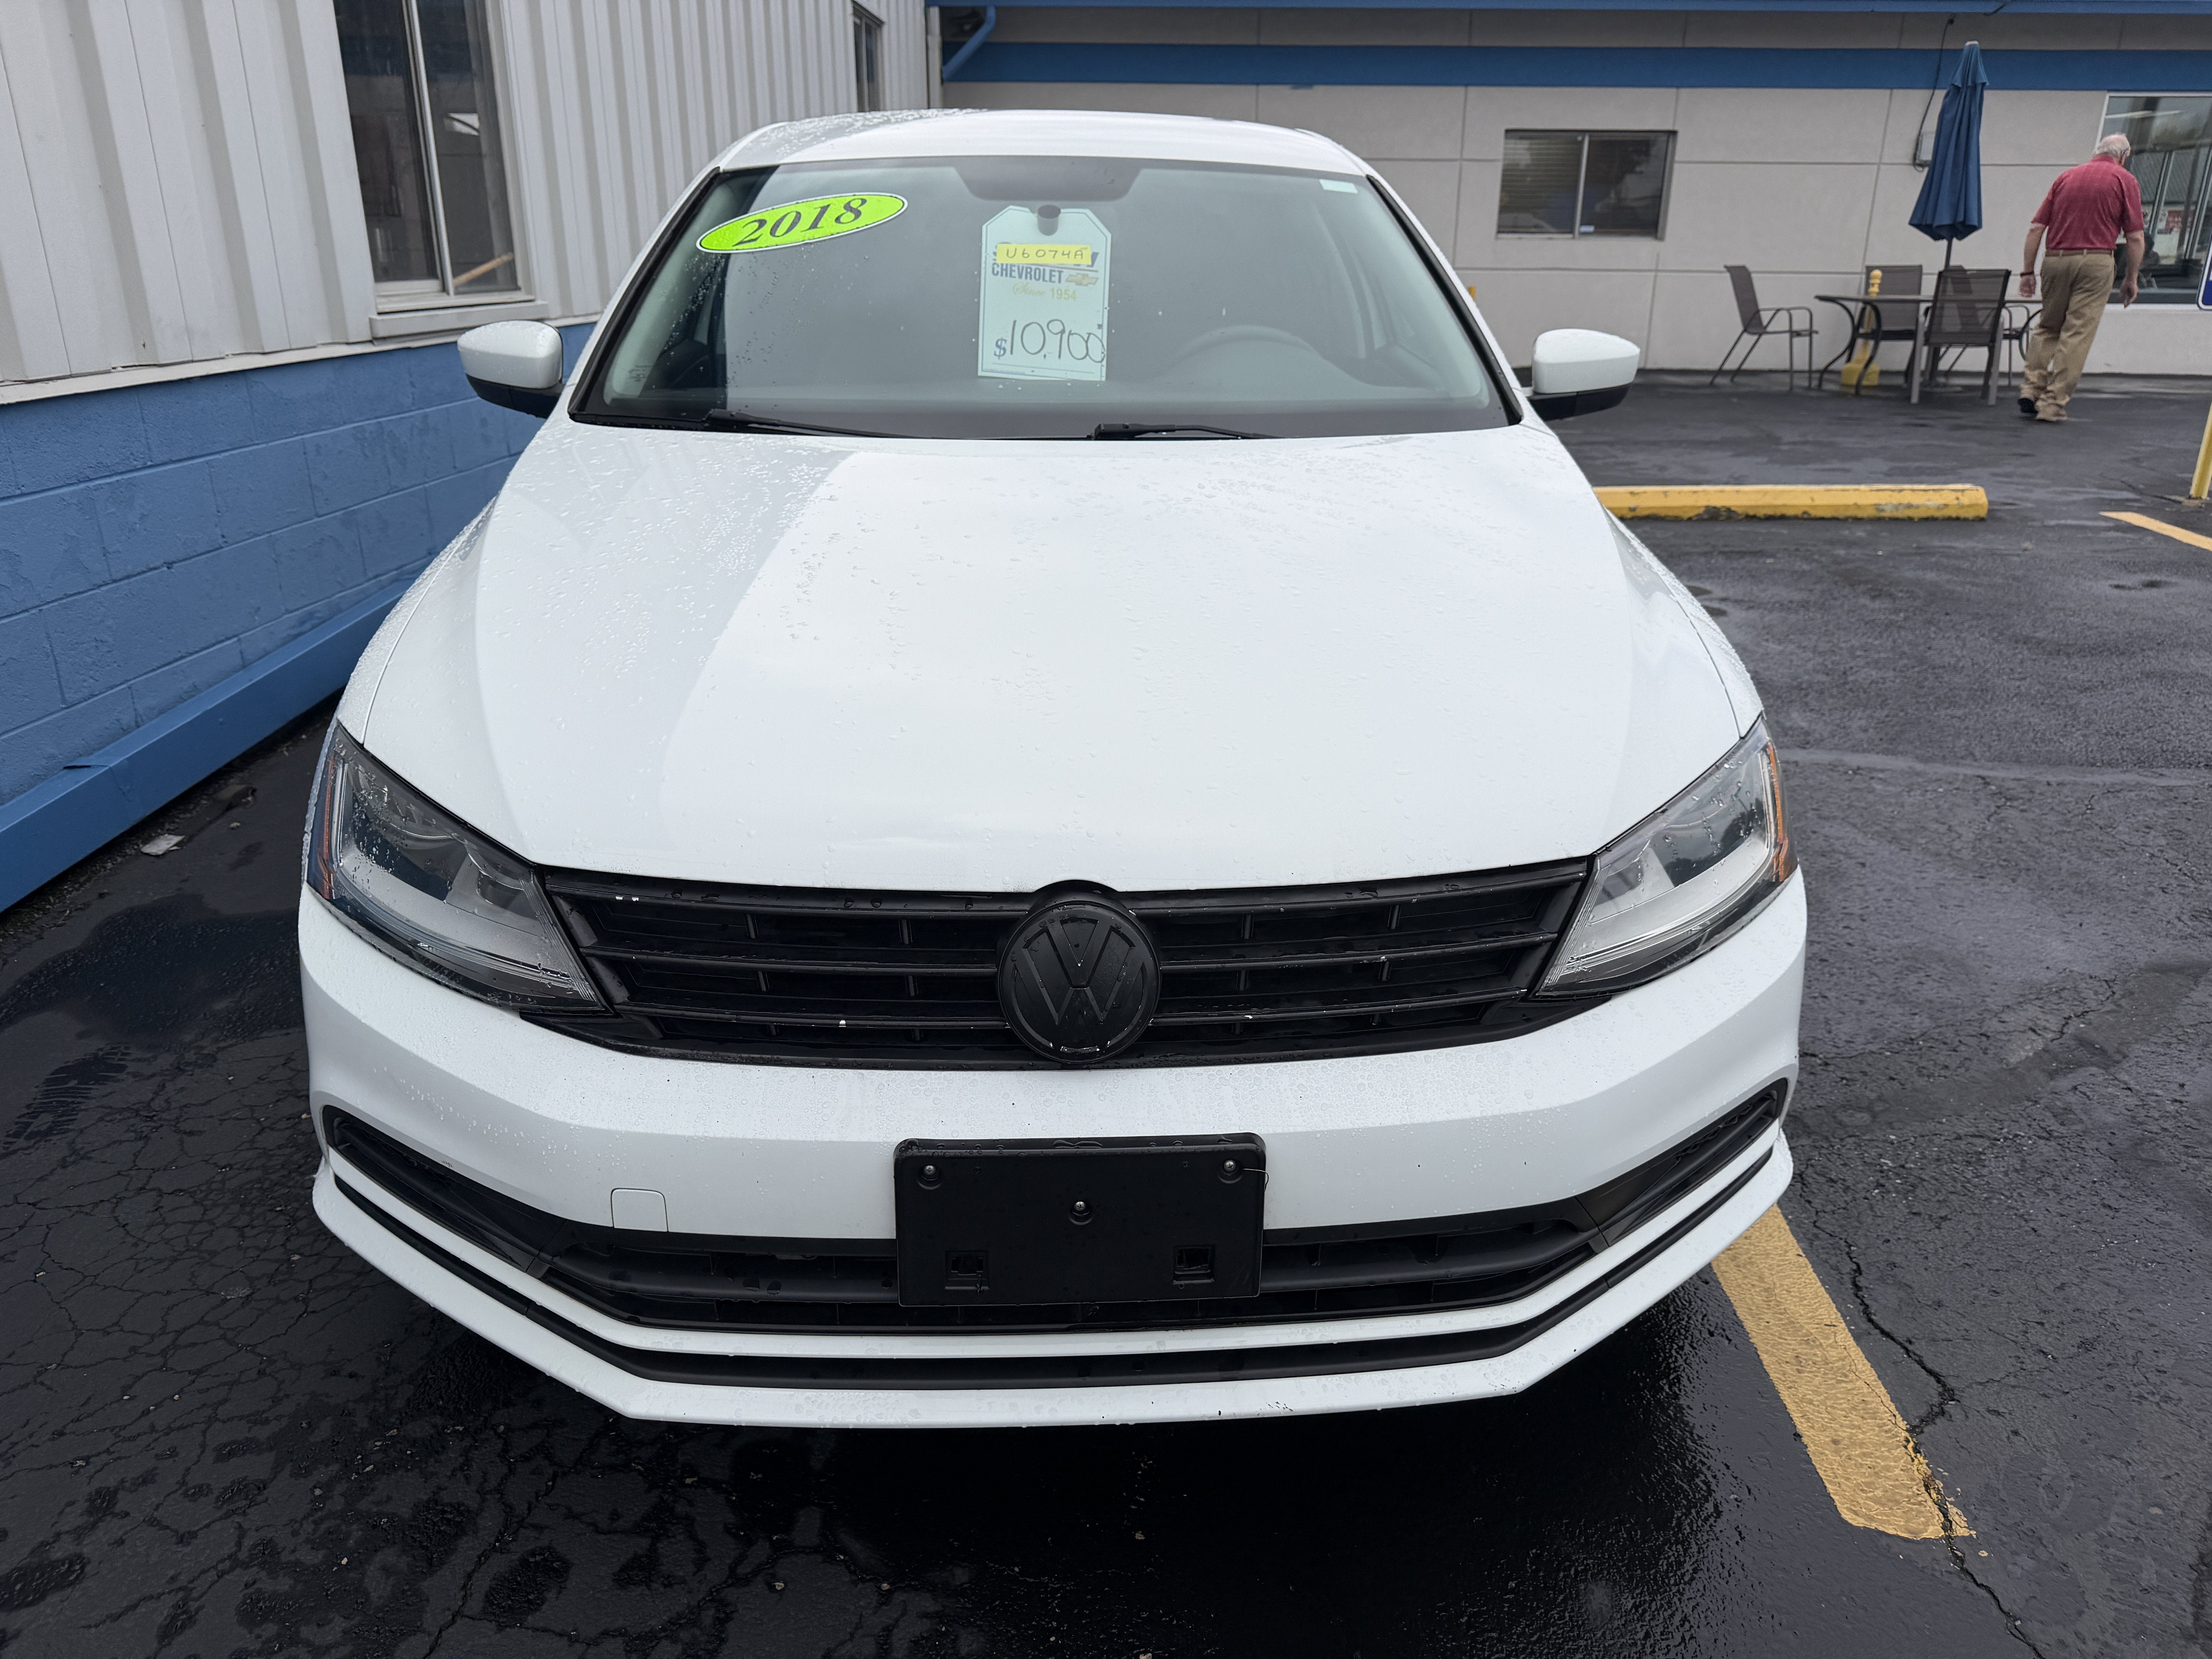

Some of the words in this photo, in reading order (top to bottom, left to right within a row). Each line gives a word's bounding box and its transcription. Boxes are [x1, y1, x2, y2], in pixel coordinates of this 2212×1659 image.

[732, 198, 867, 247] 2018
[992, 262, 1064, 283] CHEVROLET
[1050, 287, 1077, 301] 1954
[1010, 913, 1149, 1048] VW
